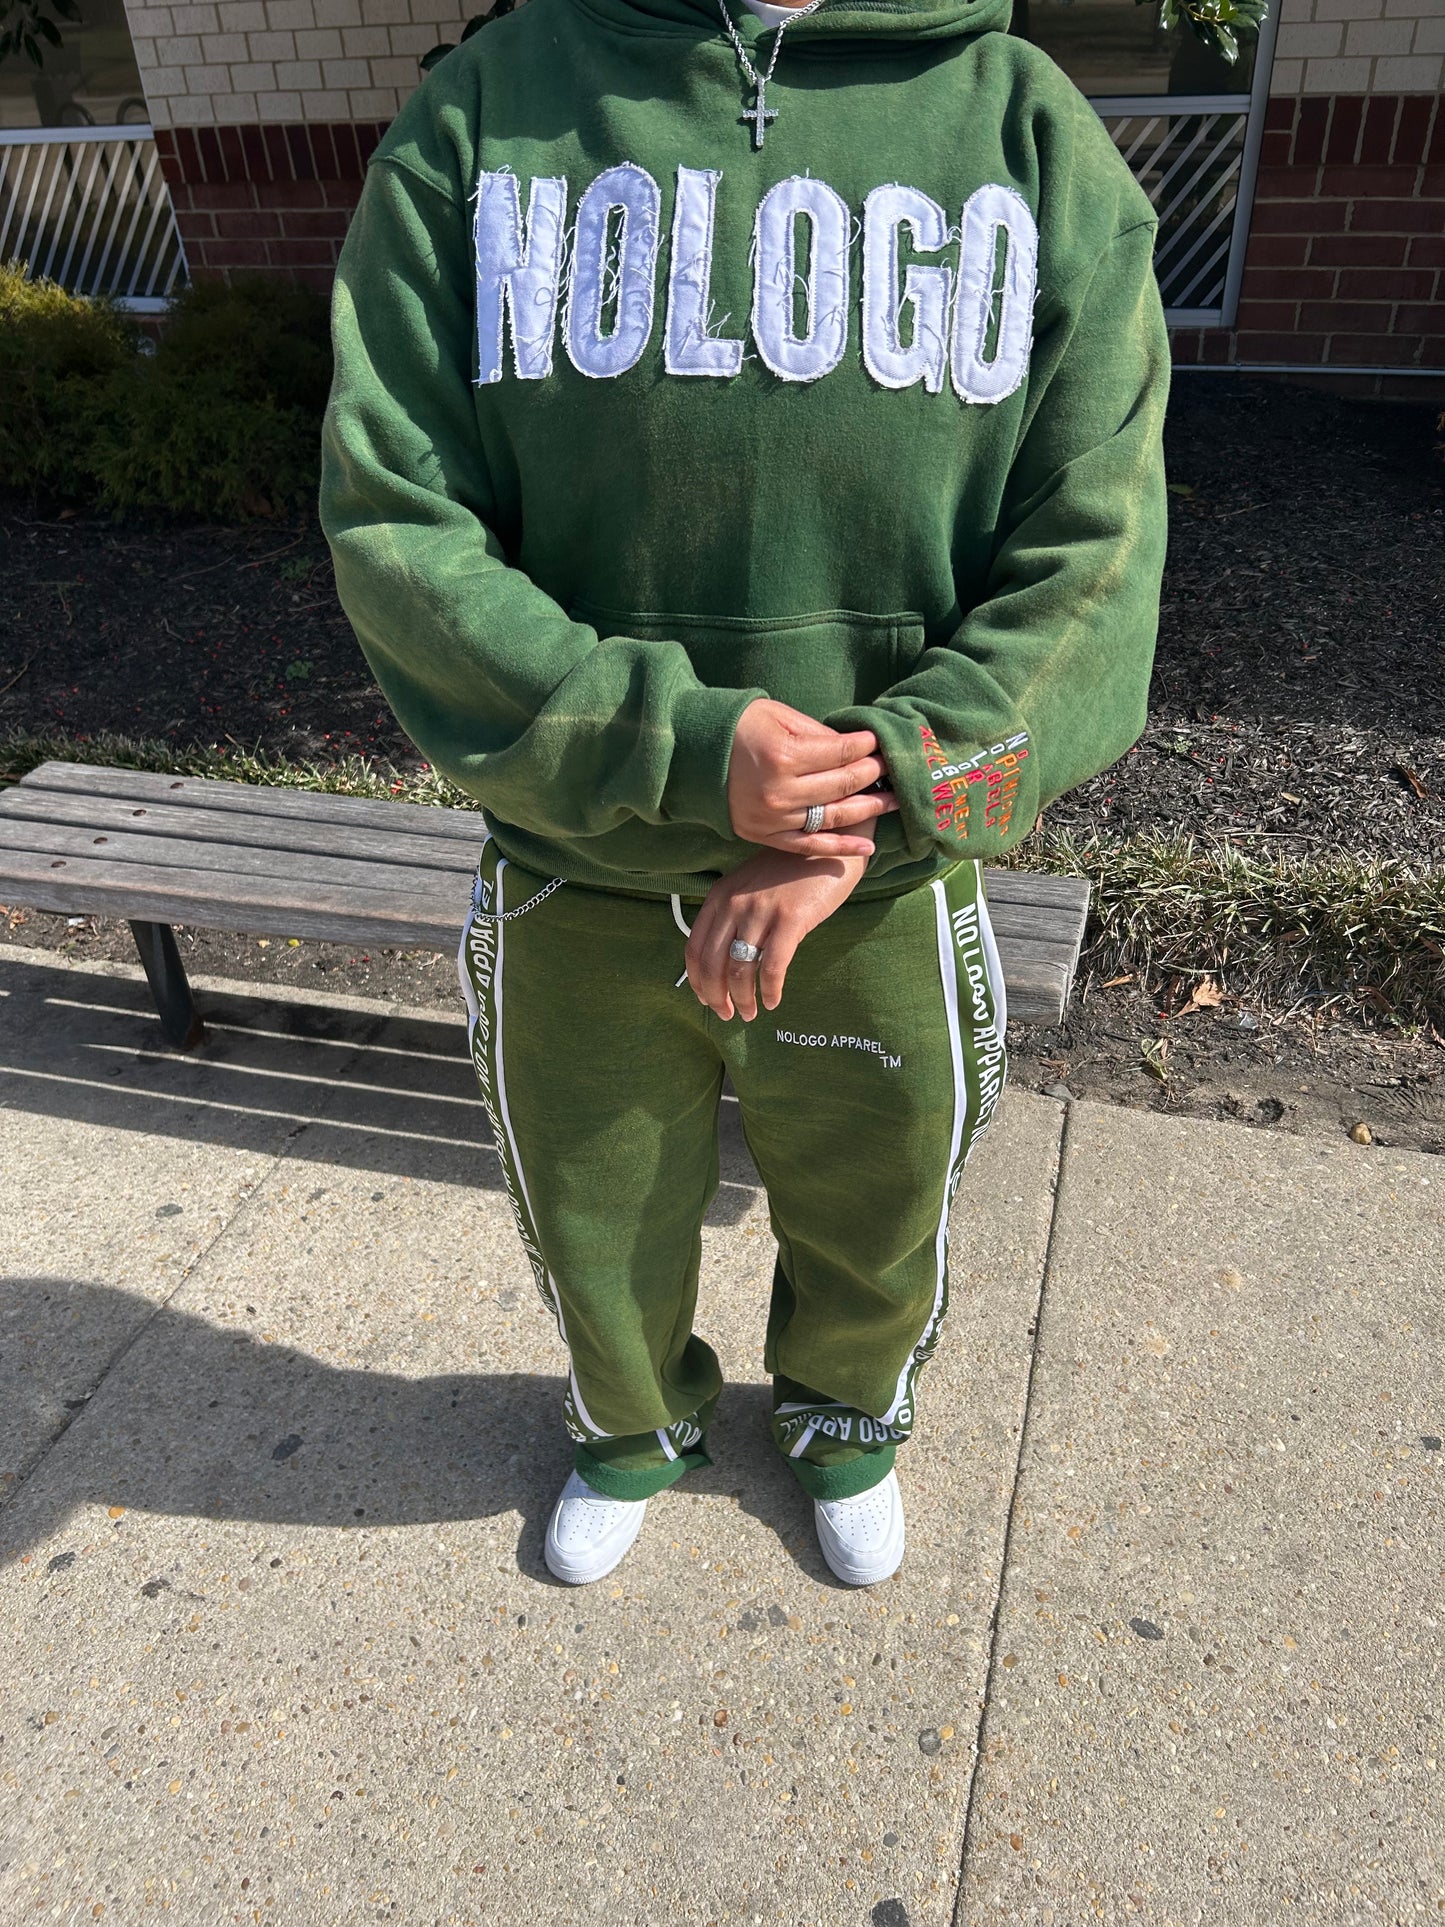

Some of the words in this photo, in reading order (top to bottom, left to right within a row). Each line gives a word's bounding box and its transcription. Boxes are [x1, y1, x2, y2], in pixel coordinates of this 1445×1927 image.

[472, 161, 1040, 404] NOLOGO
[776, 1029, 827, 1047] NOLOGO
[830, 1034, 886, 1054] APPAREL
[880, 1055, 902, 1068] TM
